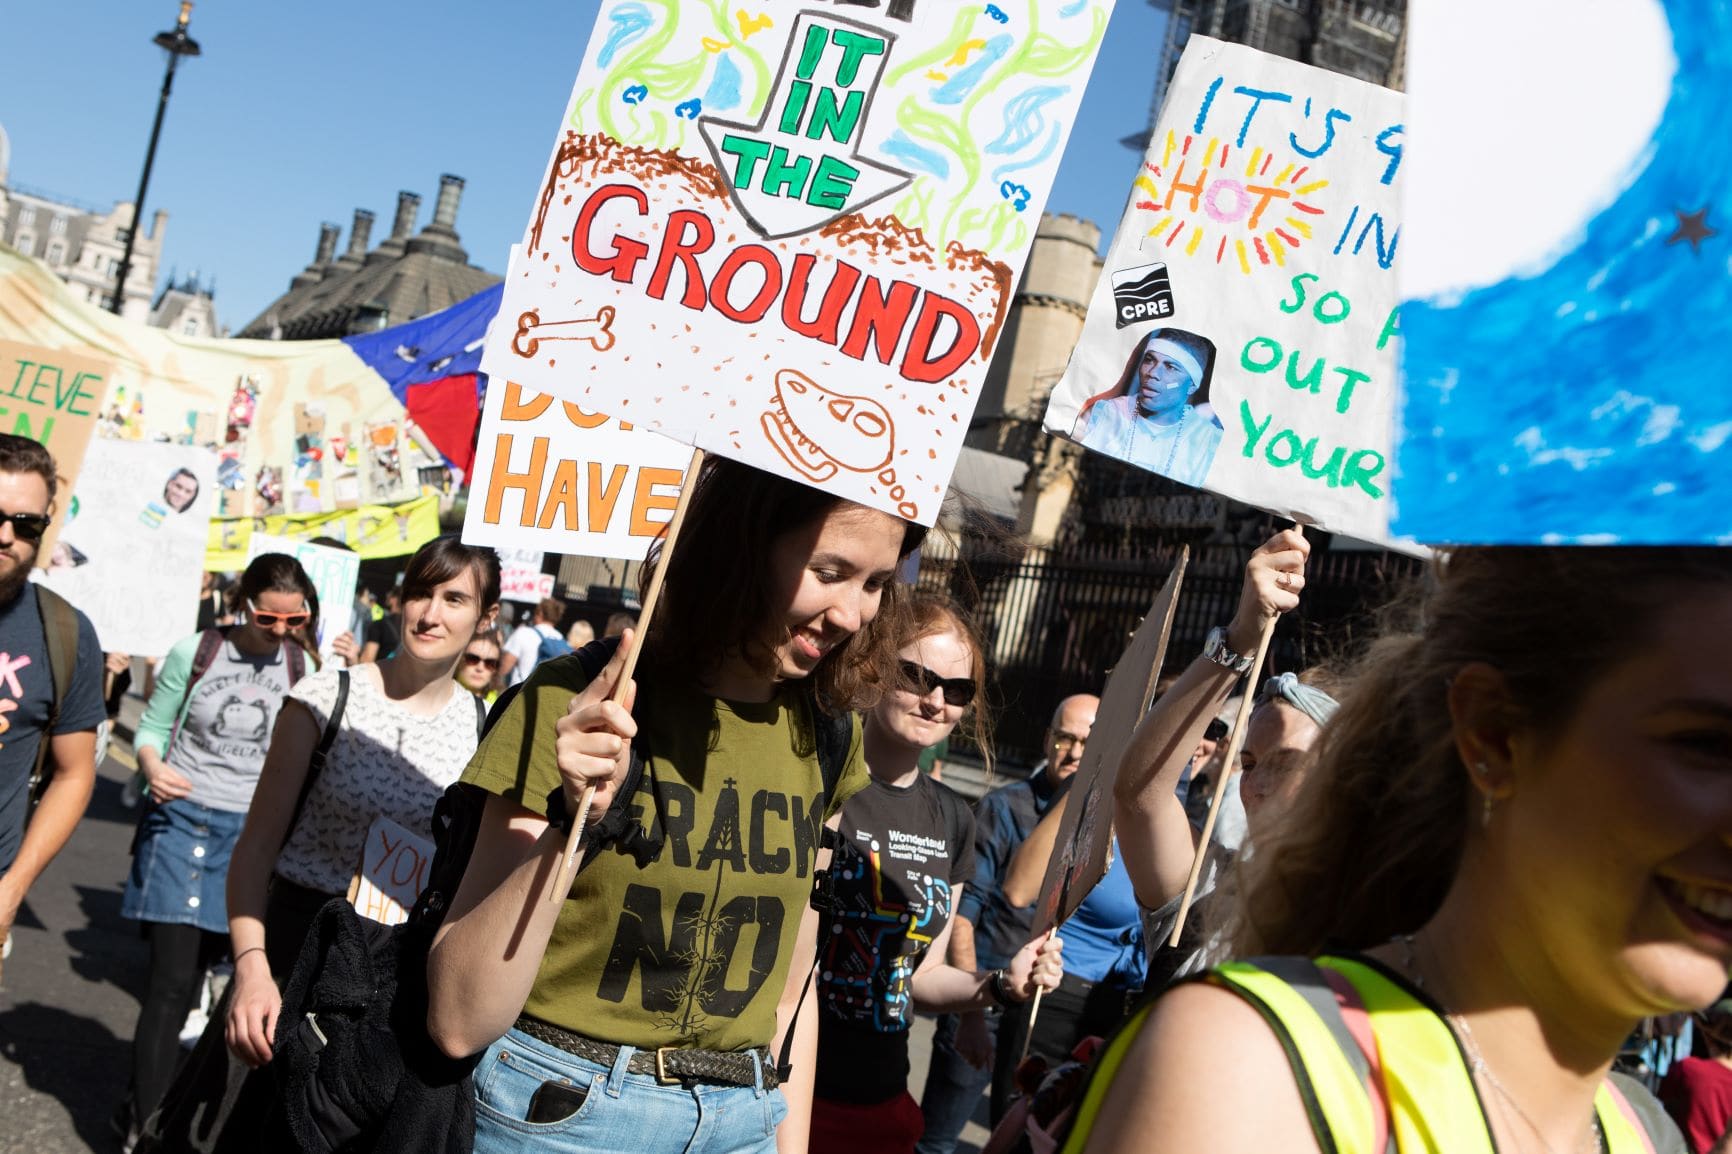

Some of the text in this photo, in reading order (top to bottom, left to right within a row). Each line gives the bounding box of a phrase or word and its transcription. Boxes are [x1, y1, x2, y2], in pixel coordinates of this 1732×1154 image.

[796, 24, 884, 88] IT
[778, 80, 865, 144] IN
[1194, 77, 1351, 159] IT'S
[722, 134, 860, 210] THE
[1164, 159, 1290, 231] HOT
[1333, 205, 1401, 270] IN
[571, 184, 981, 383] GROUND
[1121, 298, 1170, 320] CPRE
[1279, 272, 1351, 325] SO
[0, 359, 104, 417] IEVE
[1240, 335, 1372, 415] OUT
[483, 433, 684, 539] HAVE
[1239, 398, 1386, 500] YOUR
[596, 883, 785, 1018] NO
